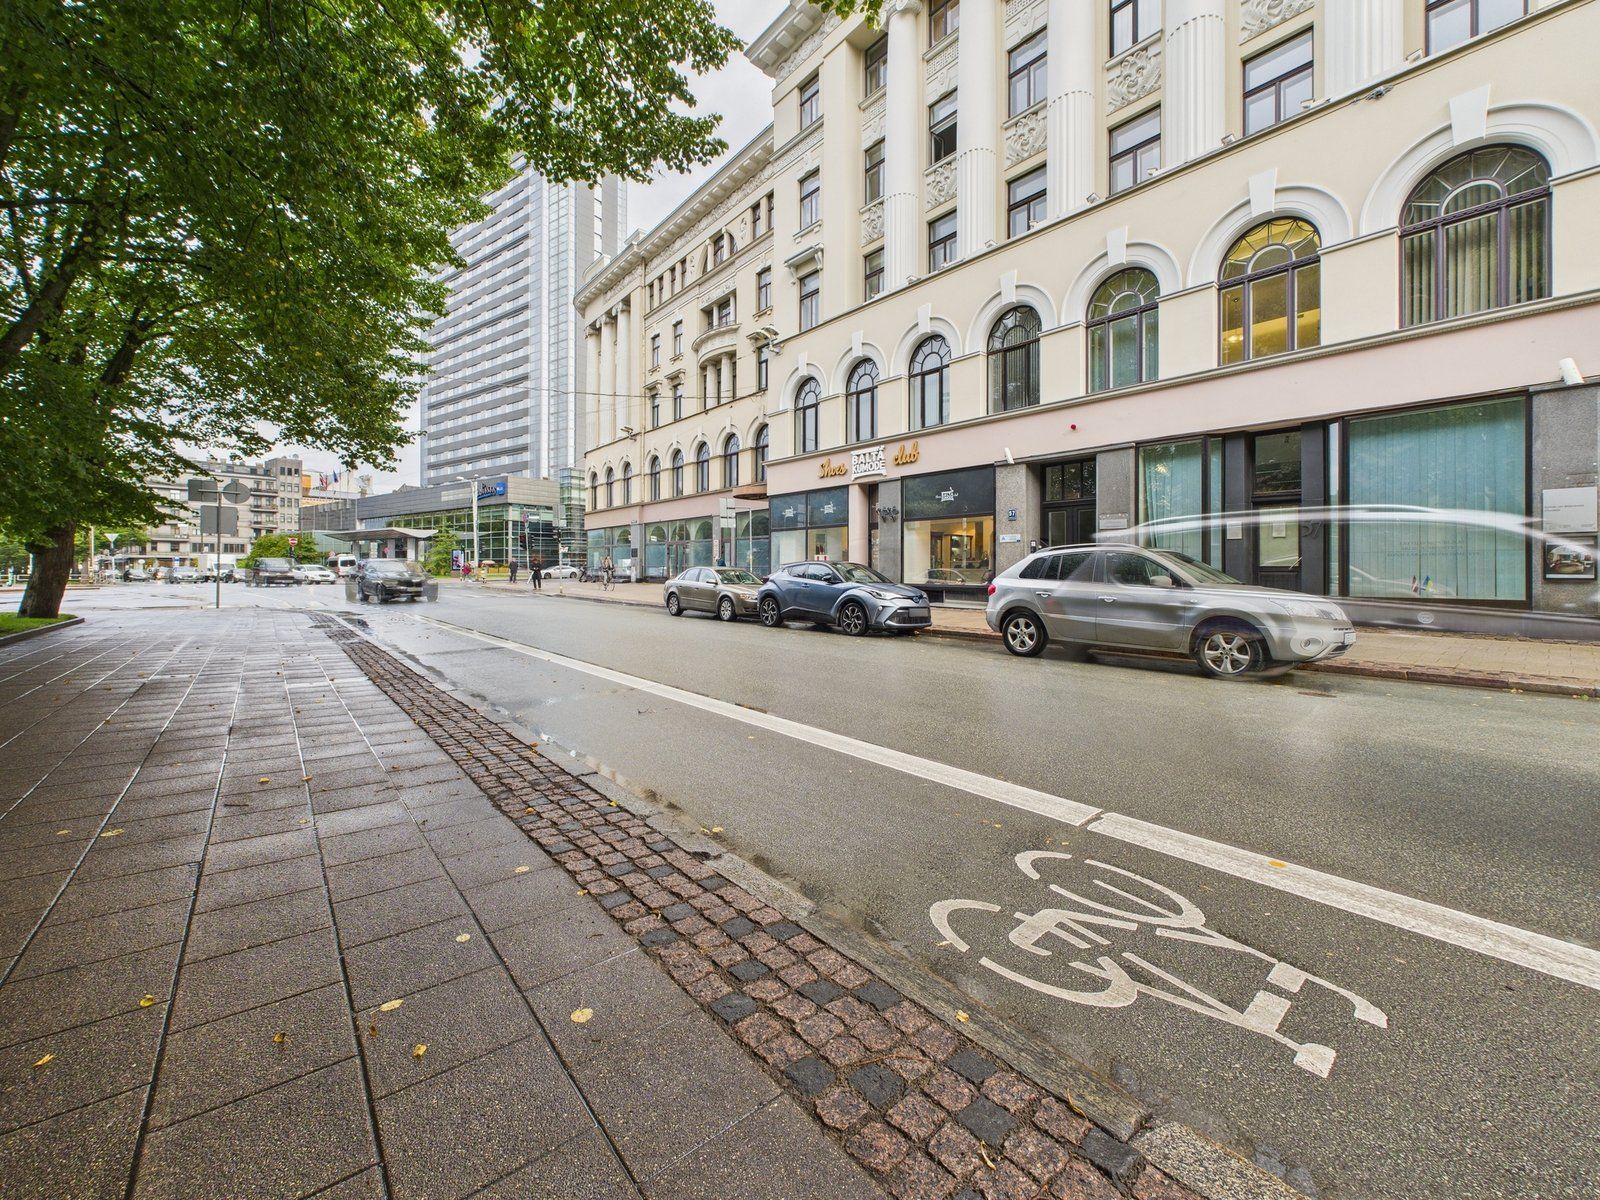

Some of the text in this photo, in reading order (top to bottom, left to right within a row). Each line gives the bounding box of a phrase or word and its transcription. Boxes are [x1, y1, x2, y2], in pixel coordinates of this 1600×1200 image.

[892, 440, 920, 465] club
[818, 457, 848, 478] Shoes
[853, 461, 886, 475] KUMODE
